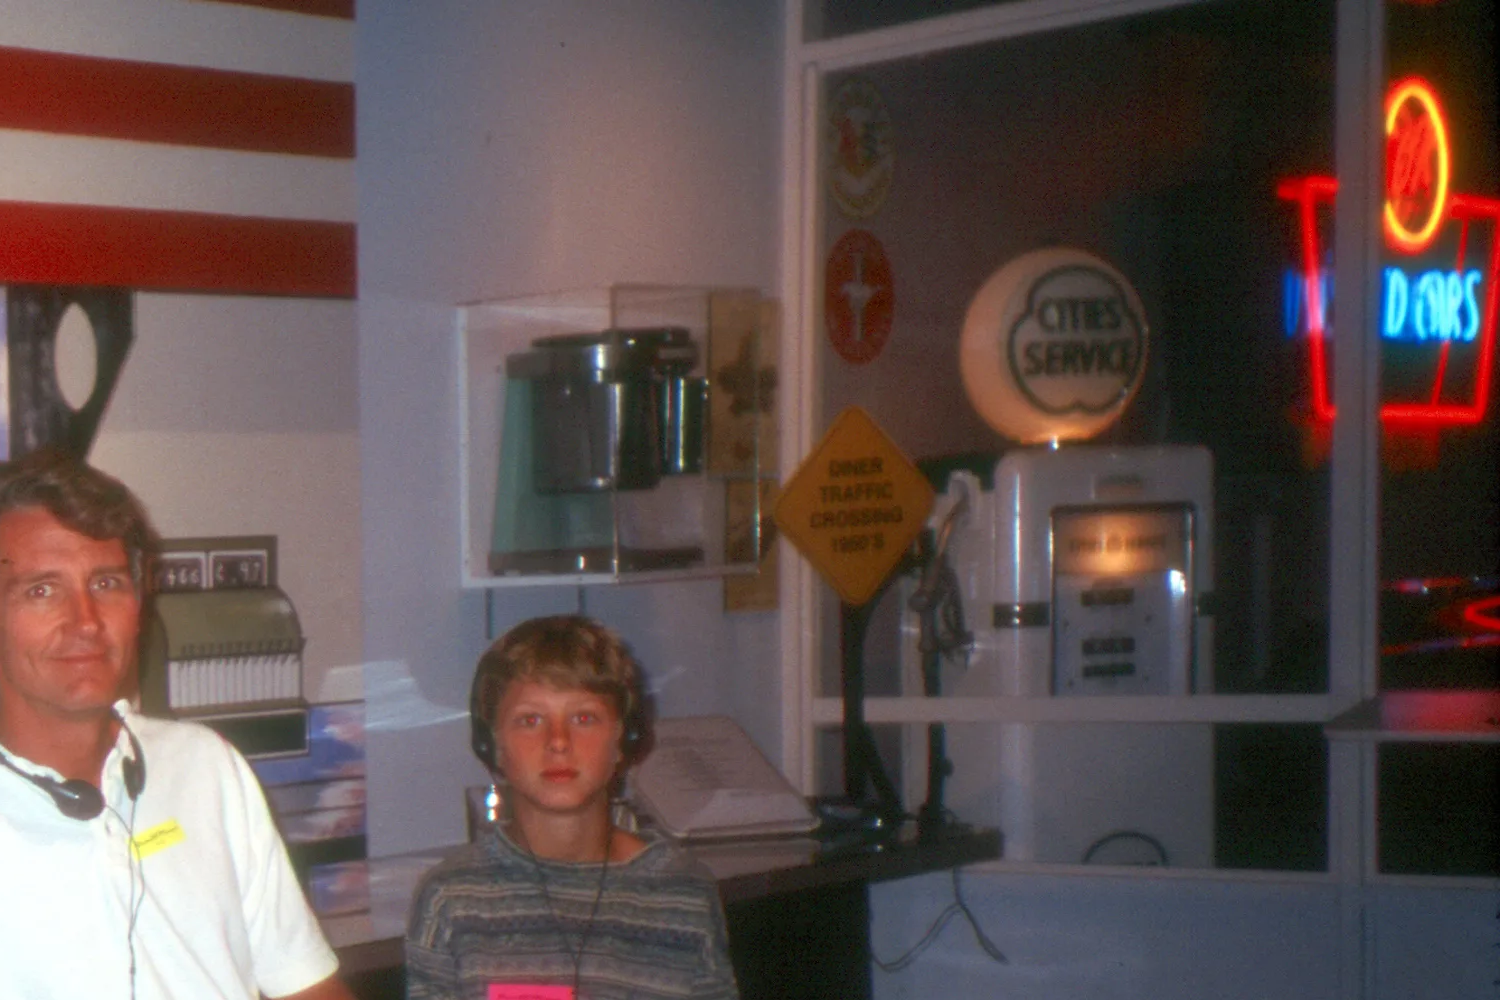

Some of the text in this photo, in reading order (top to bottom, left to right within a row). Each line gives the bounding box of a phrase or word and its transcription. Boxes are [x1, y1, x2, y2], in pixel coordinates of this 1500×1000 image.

[1038, 296, 1122, 332] CITIES
[1413, 266, 1483, 342] CARS
[1024, 338, 1134, 377] SERVICE
[829, 456, 884, 478] DINER
[819, 481, 894, 504] TRAFFIC
[810, 505, 904, 529] CROSSING
